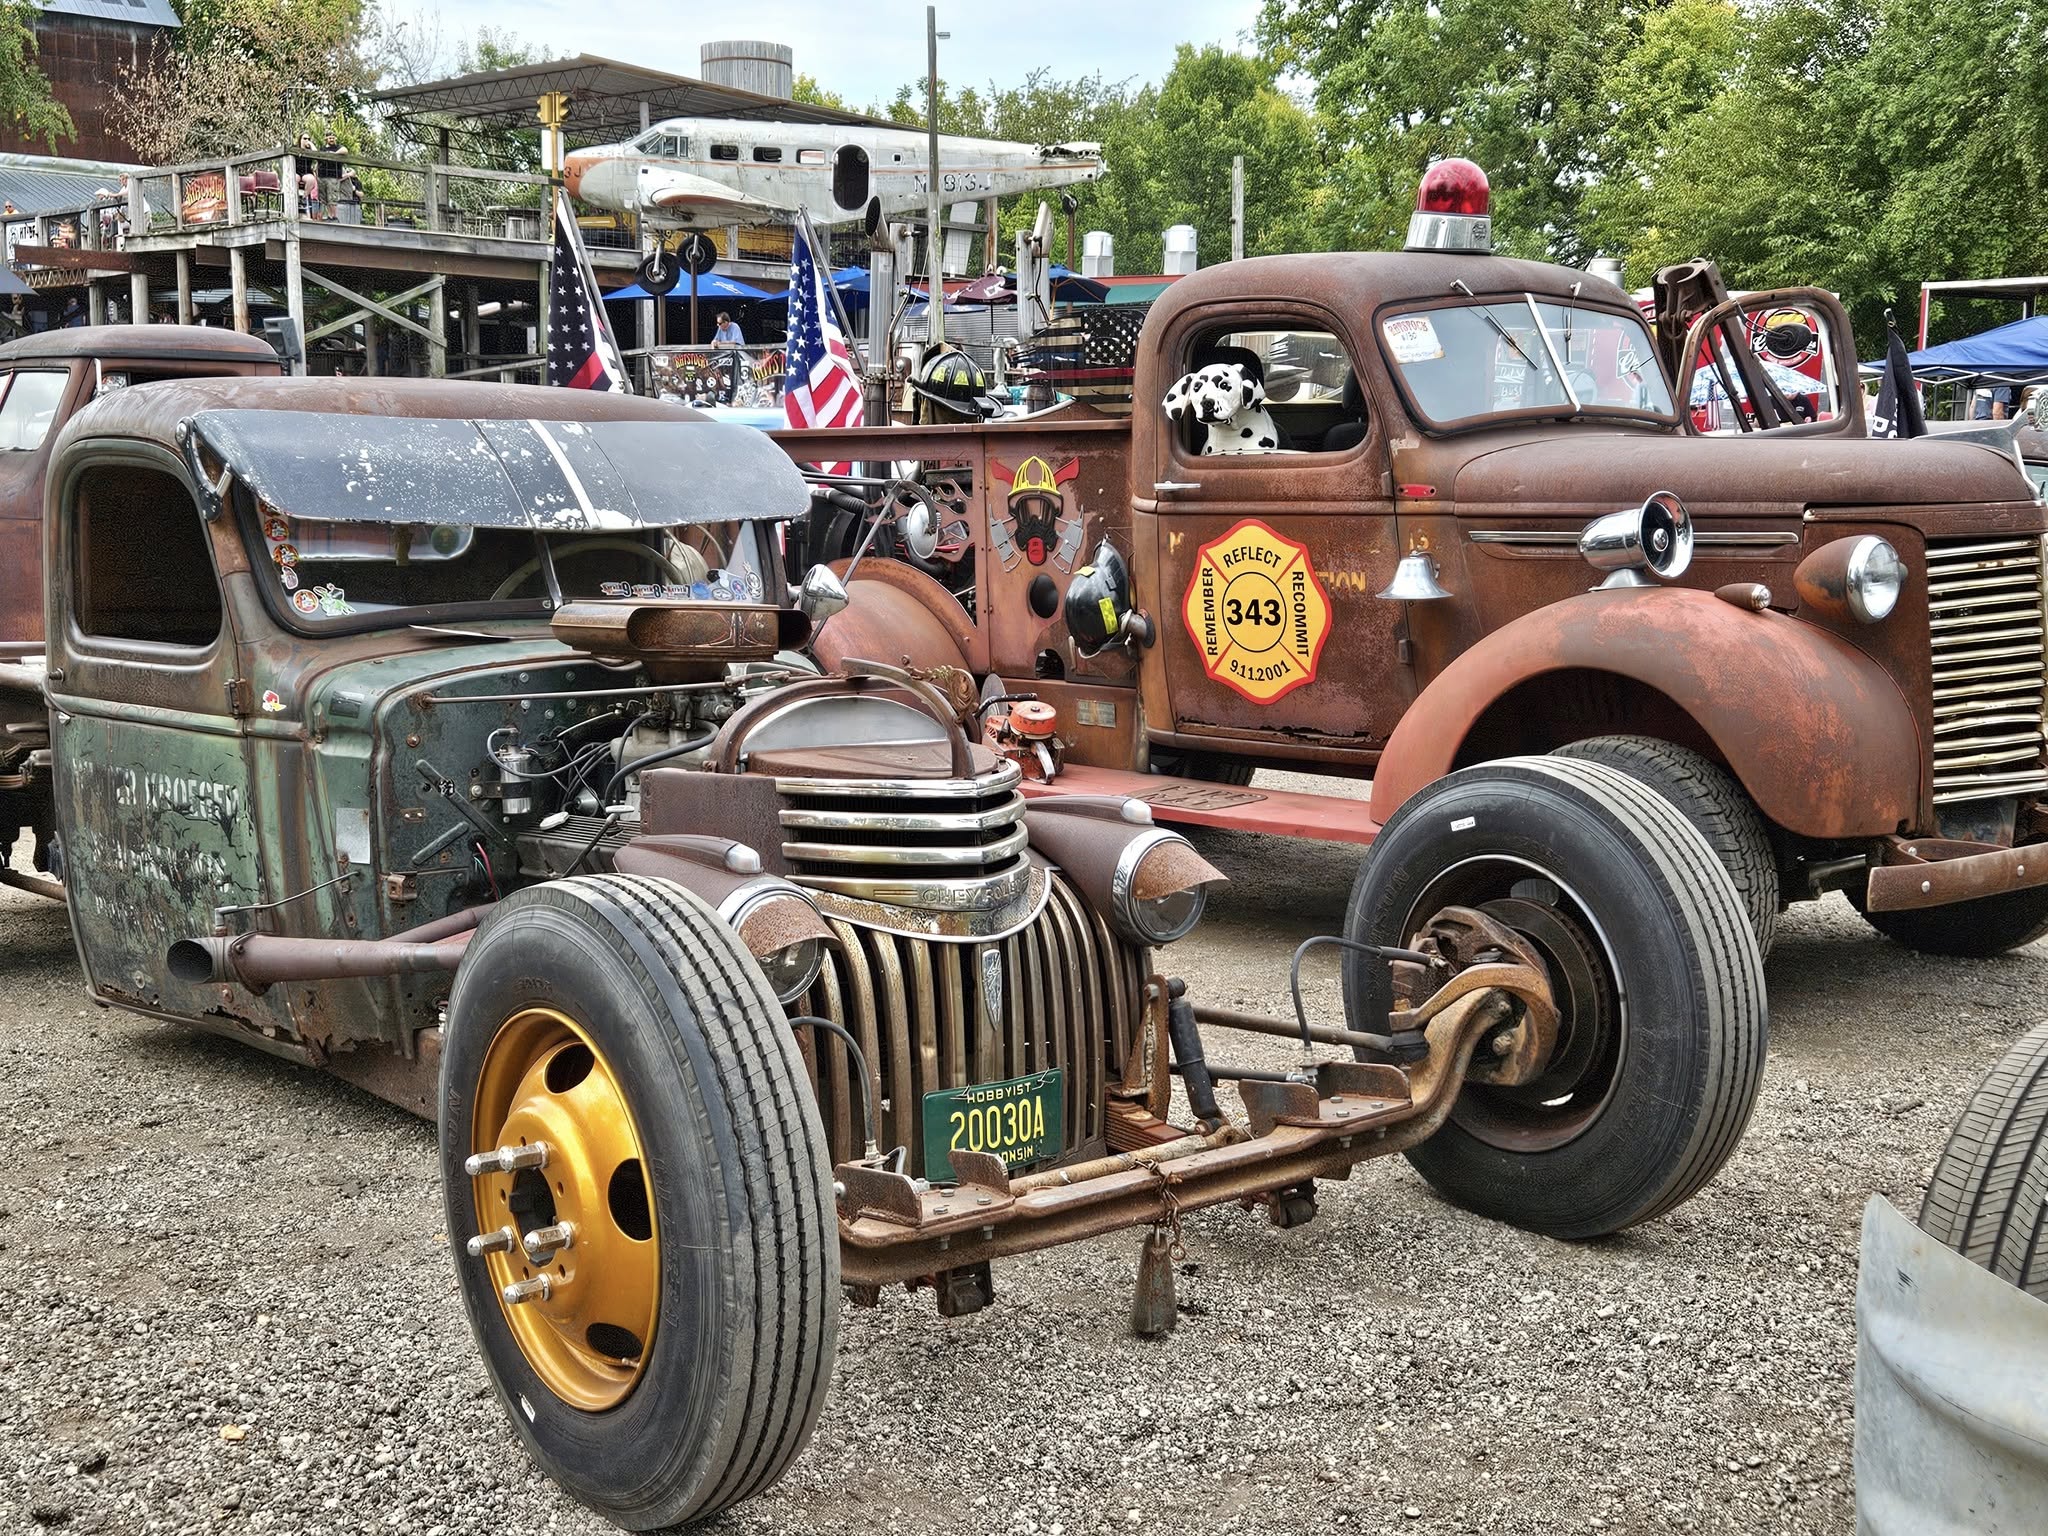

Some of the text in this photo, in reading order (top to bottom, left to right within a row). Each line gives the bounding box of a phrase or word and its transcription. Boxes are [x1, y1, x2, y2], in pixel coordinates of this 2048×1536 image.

[914, 173, 991, 193] N813J
[1223, 546, 1281, 568] REFLECT
[1202, 567, 1218, 656] REMEMBER
[1226, 598, 1281, 626] 343
[1292, 571, 1309, 657] RECOMMIT
[1229, 659, 1291, 682] 9.11.2001
[967, 1082, 1031, 1104] HOBBYIST
[950, 1095, 1045, 1152] 20030A
[1000, 1145, 1034, 1164] ONSIN
